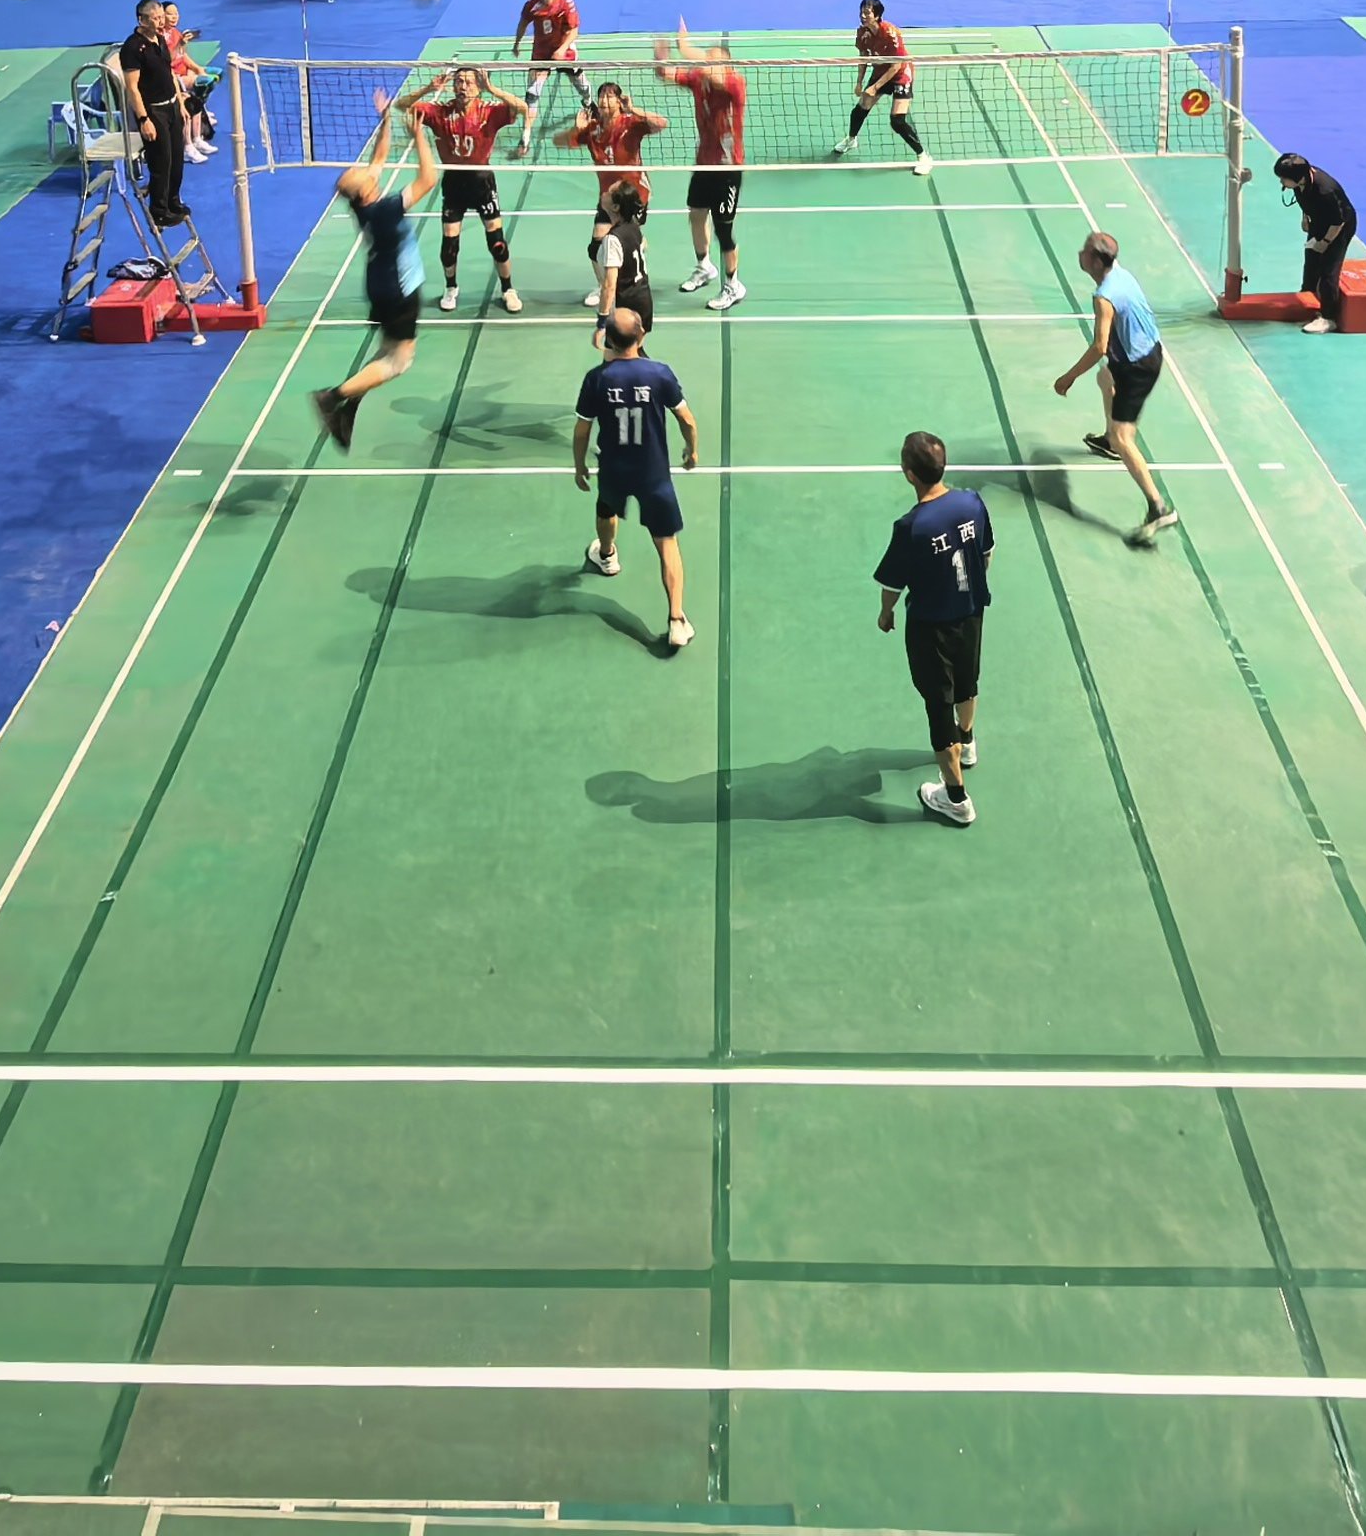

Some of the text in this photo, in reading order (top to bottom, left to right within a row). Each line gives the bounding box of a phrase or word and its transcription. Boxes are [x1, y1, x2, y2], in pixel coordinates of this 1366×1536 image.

[1188, 91, 1205, 114] 2
[606, 385, 652, 403] 江西
[615, 407, 643, 445] 11
[931, 520, 976, 554] 江西
[951, 549, 970, 592] 1
